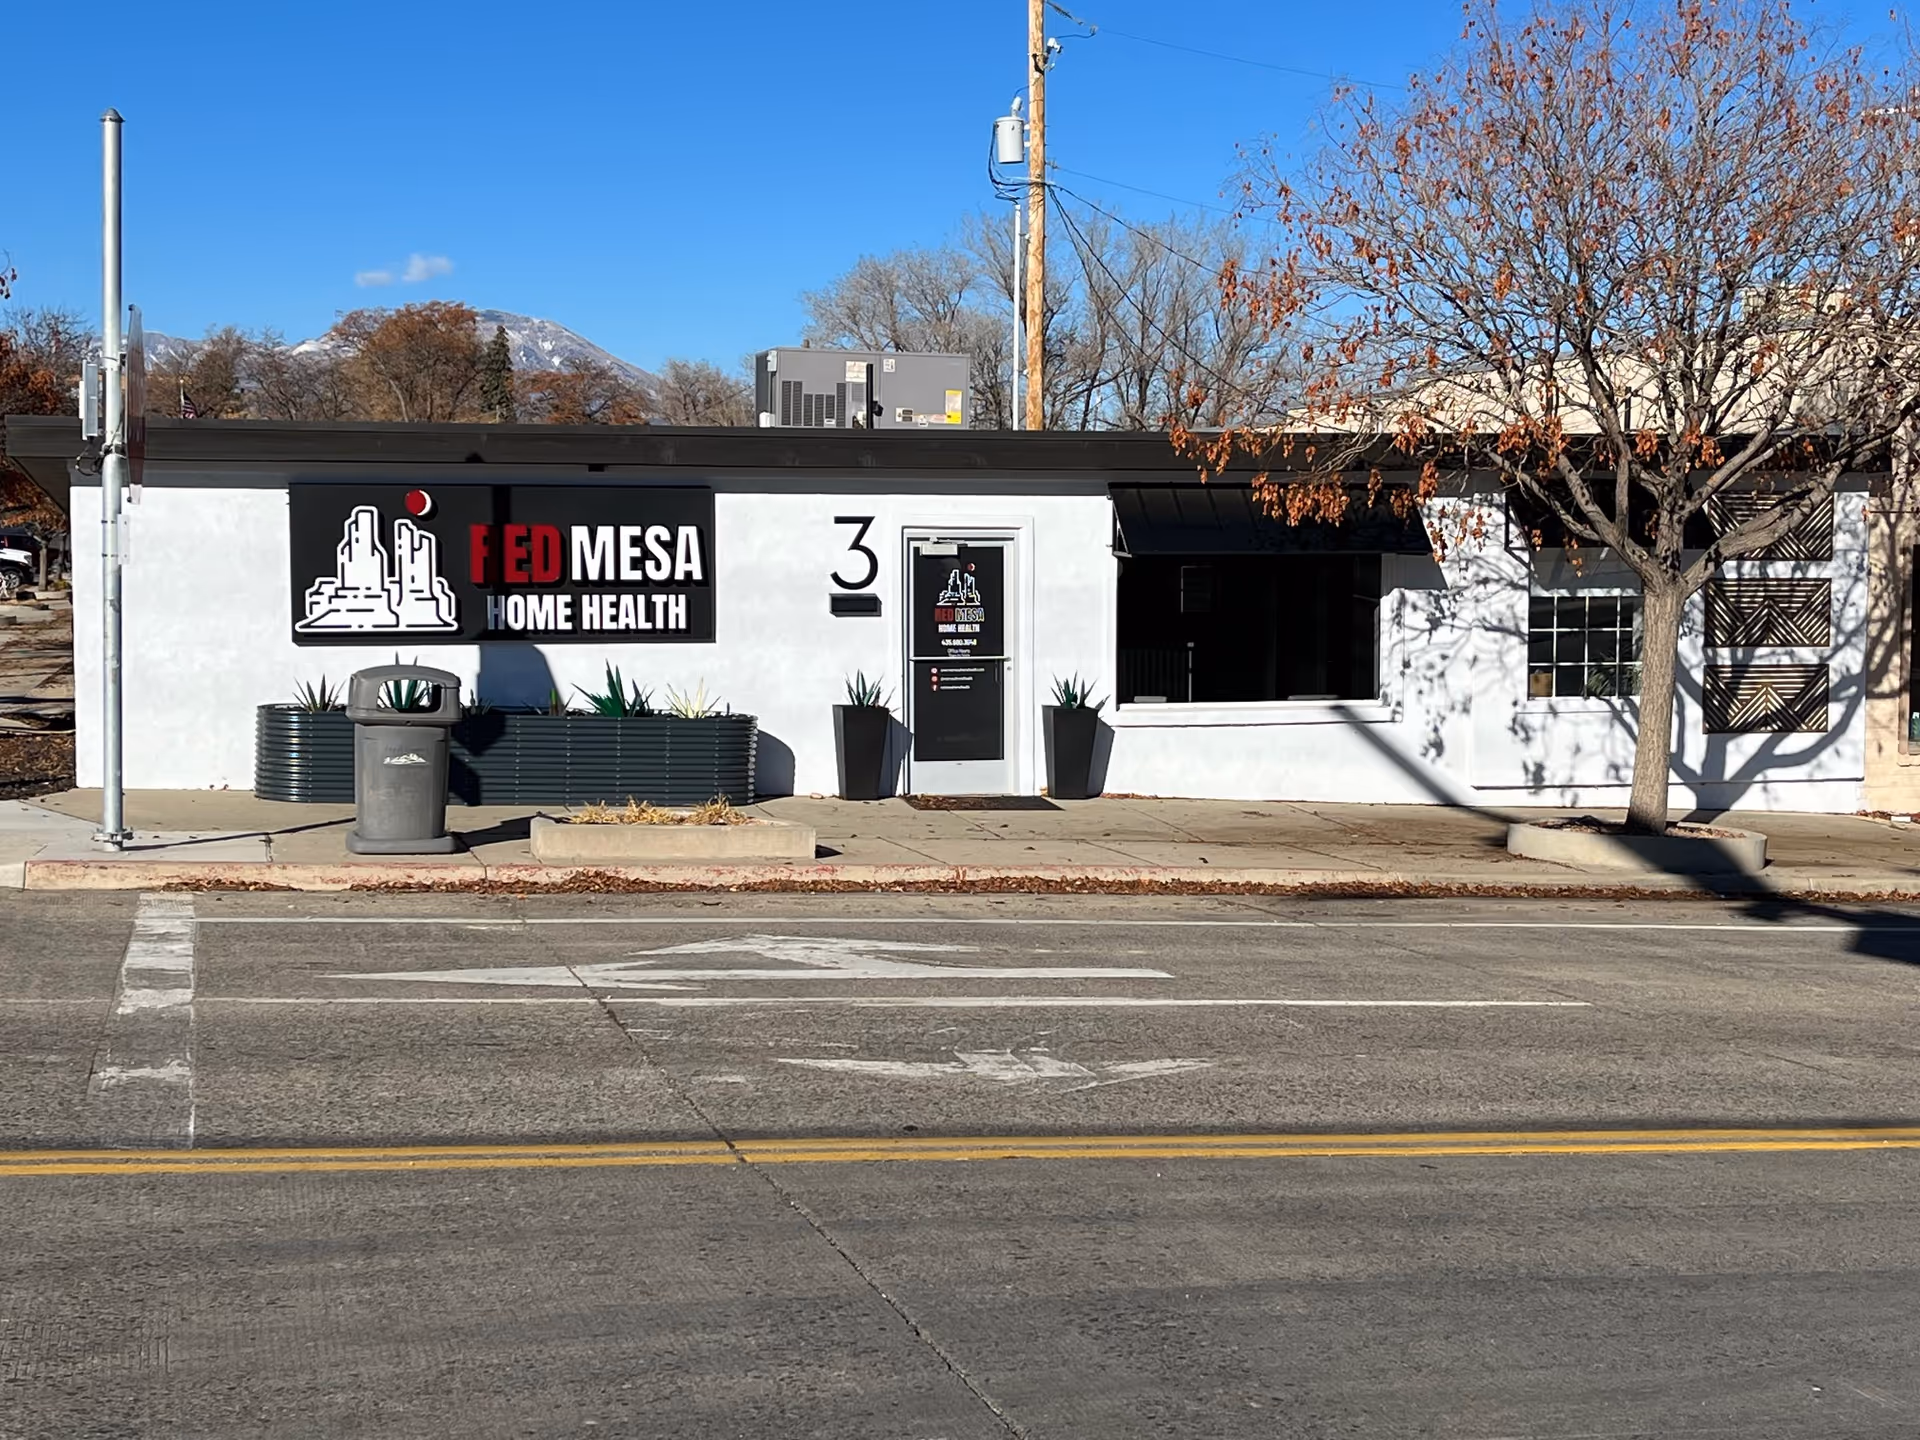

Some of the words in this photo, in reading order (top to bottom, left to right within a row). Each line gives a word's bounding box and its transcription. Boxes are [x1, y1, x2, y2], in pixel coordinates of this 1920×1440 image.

[570, 525, 703, 581] MESA
[829, 515, 879, 591] 3
[487, 594, 573, 631] HOME
[581, 594, 687, 630] HEALTH
[934, 607, 954, 622] RED
[954, 607, 985, 622] MESA
[938, 623, 957, 633] HOME
[957, 623, 980, 633] HEALTH
